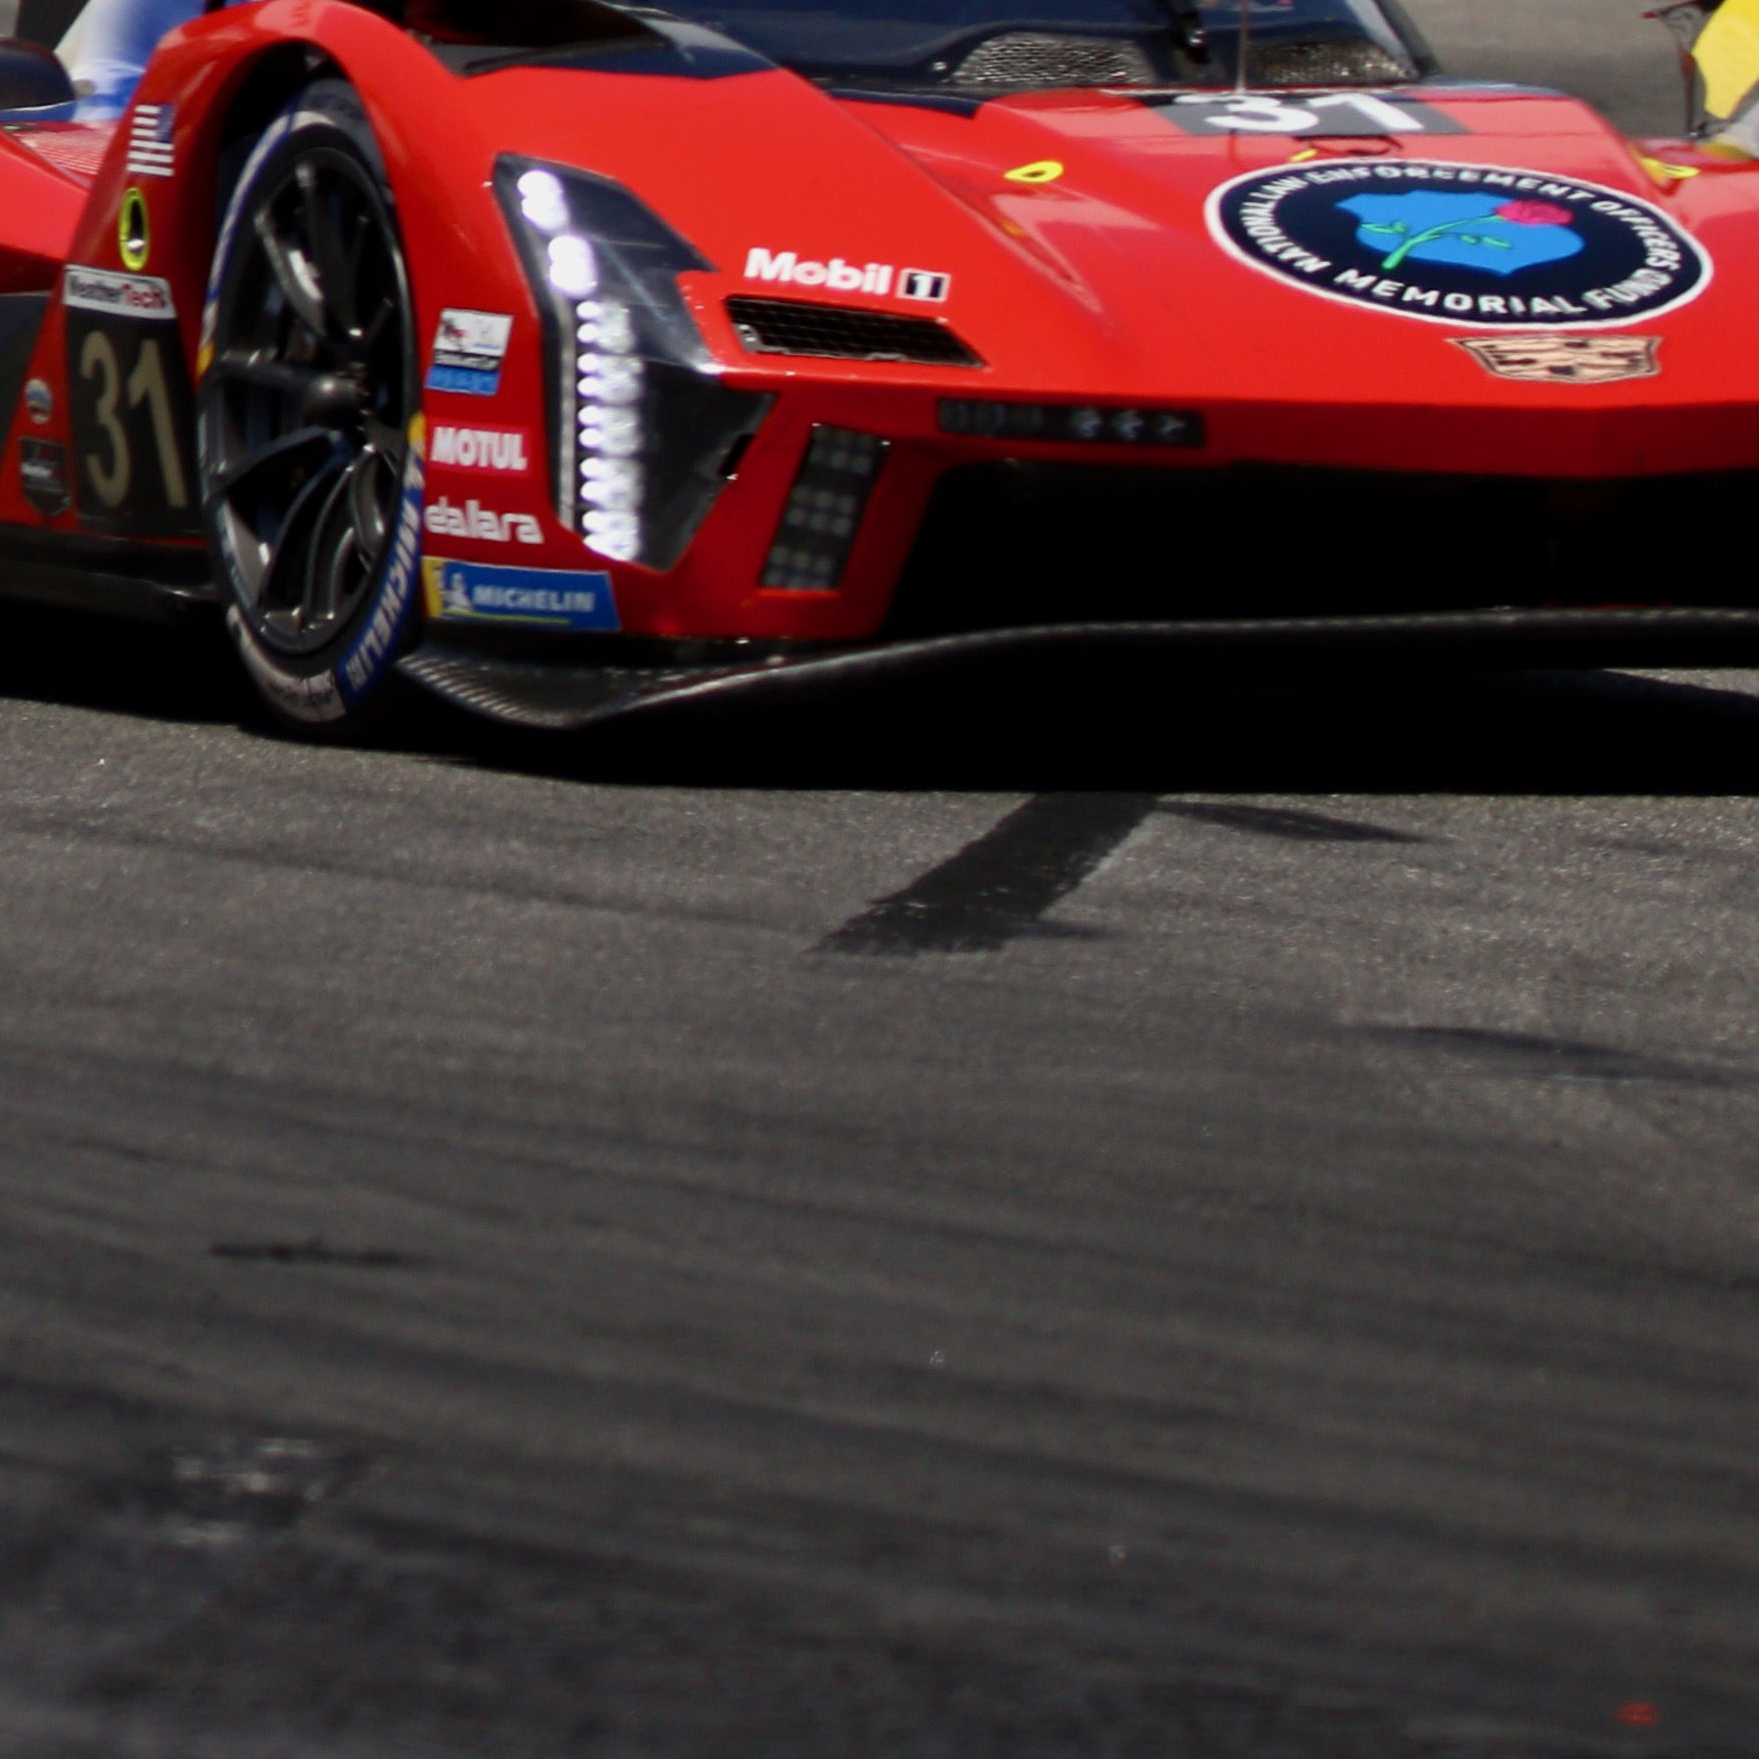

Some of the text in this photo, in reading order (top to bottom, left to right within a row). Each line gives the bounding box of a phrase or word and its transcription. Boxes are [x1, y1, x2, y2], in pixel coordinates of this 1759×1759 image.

[1173, 92, 1425, 132] 31
[1238, 201, 1332, 273] NATIONAL
[1304, 164, 1595, 201] ENFORCEMENT
[1588, 200, 1682, 271] OFFICERS
[743, 247, 893, 296] Mobil
[1333, 268, 1588, 315] MEMORIAL
[80, 330, 188, 510] 31
[432, 425, 529, 472] MOTUL
[345, 497, 421, 691] MICHELIN
[473, 583, 594, 613] MICHELIN
